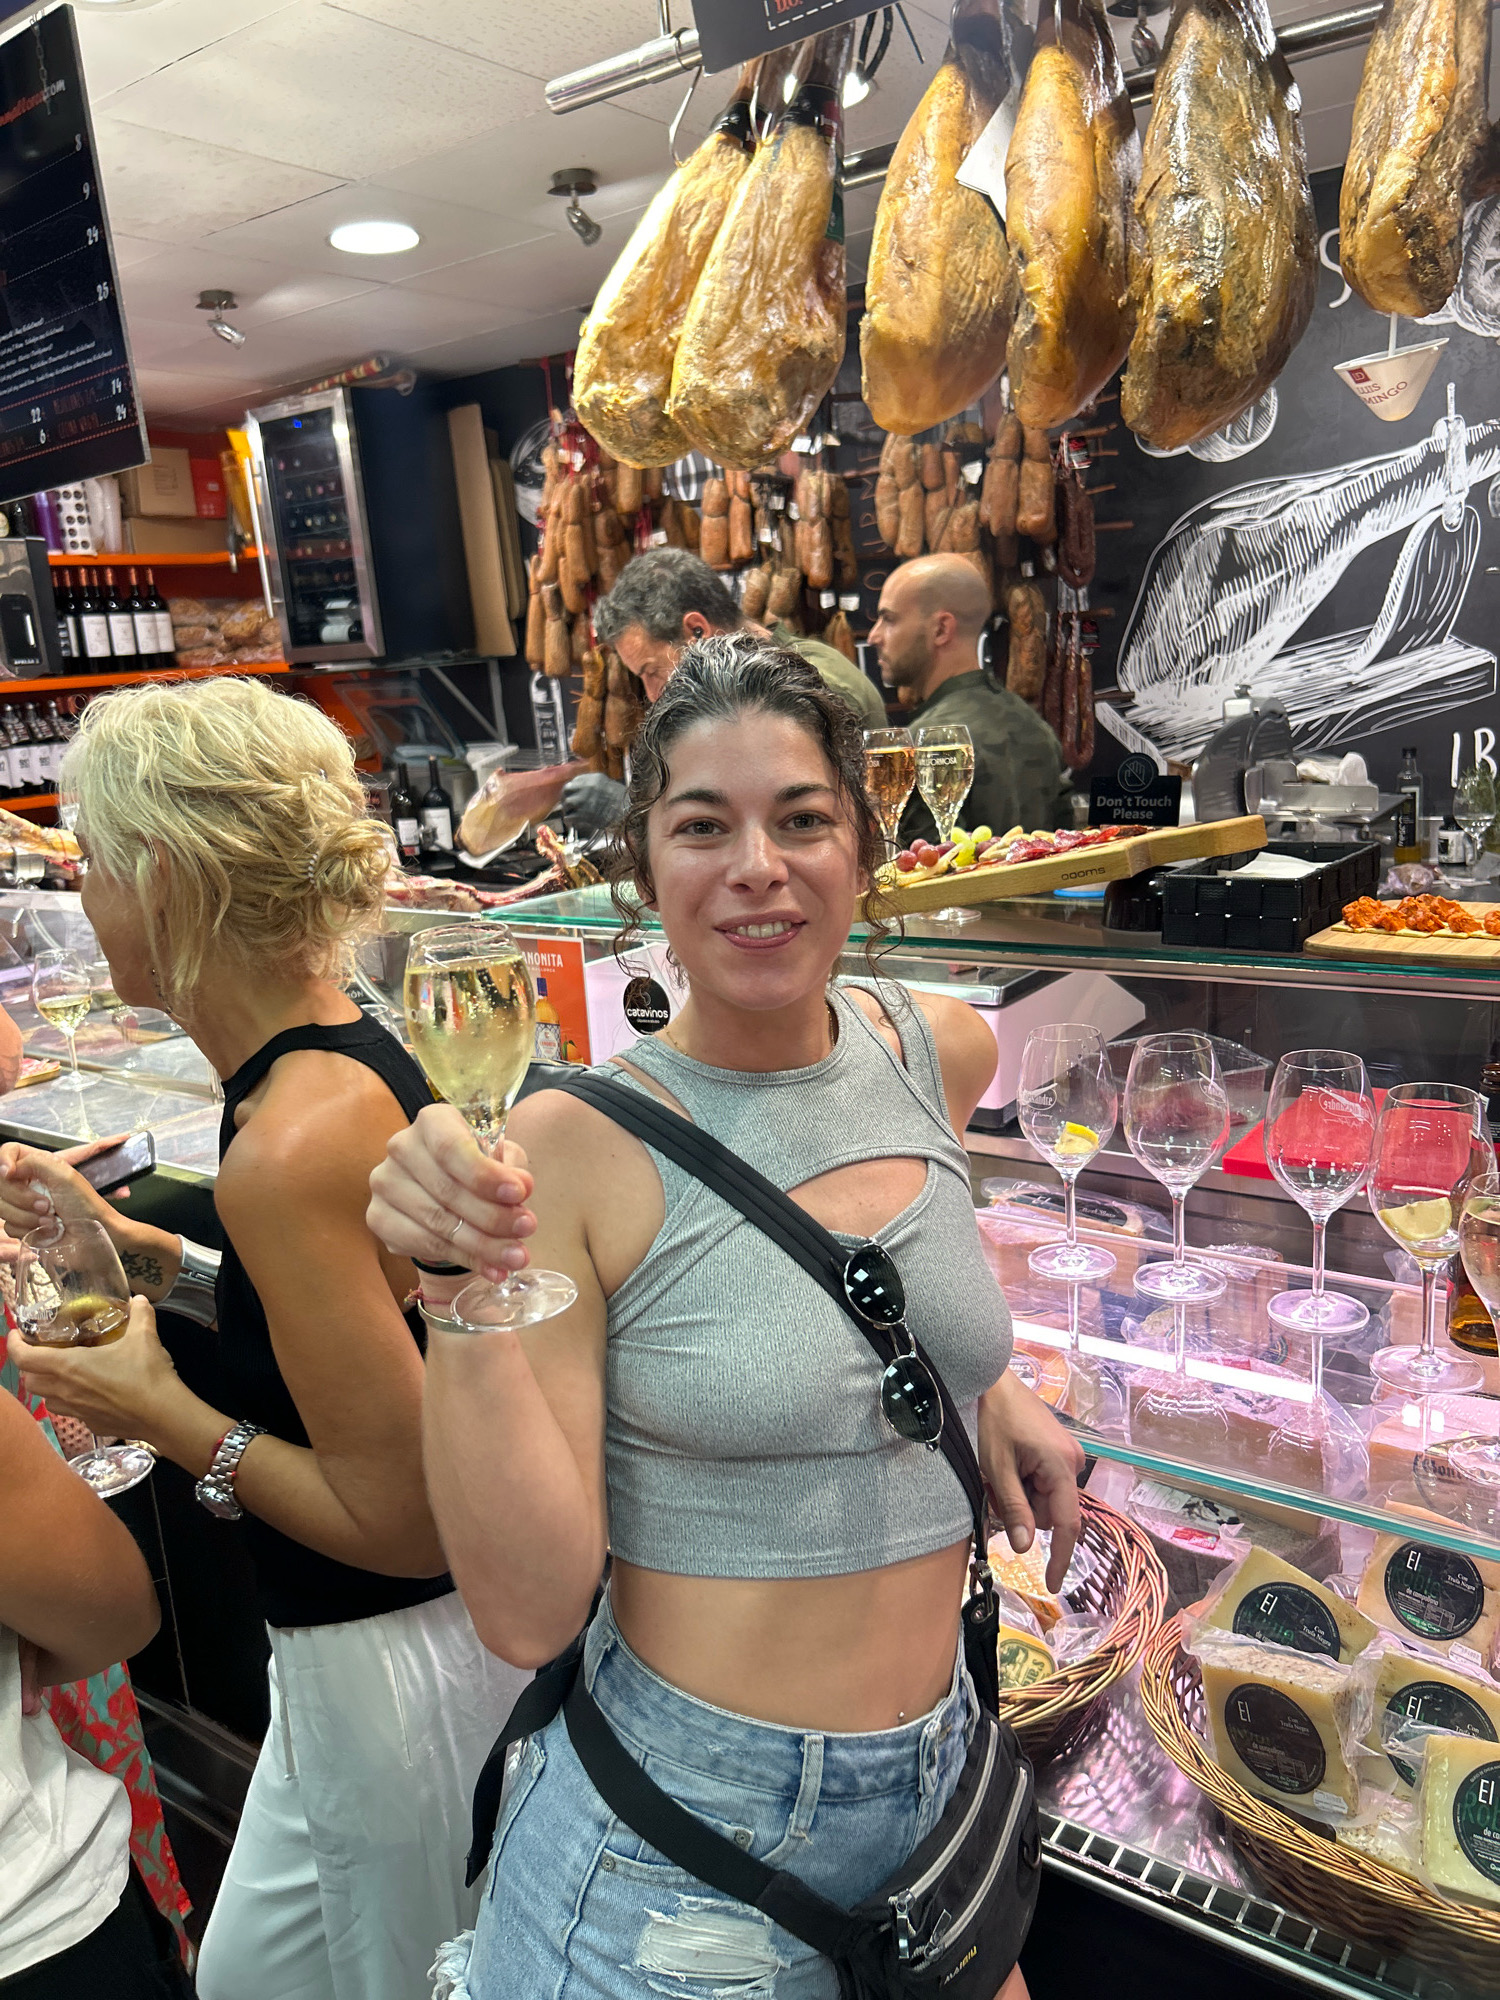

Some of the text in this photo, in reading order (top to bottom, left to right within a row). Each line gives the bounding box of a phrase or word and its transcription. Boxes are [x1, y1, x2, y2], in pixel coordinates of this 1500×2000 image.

[75, 133, 82, 151] 8
[82, 181, 91, 200] 9
[86, 225, 99, 246] 24
[96, 281, 109, 302] 25
[111, 377, 122, 395] 14
[30, 407, 41, 424] 22
[115, 403, 127, 422] 24
[39, 428, 47, 445] 6
[1134, 794, 1172, 807] Touch
[1112, 808, 1154, 820] Please
[626, 1006, 669, 1019] catavinos
[1406, 1550, 1422, 1571] El
[1447, 1574, 1476, 1591] Trufa Negra
[1457, 1573, 1469, 1582] Con
[1259, 1592, 1279, 1615] El
[1302, 1625, 1332, 1647] Trufa Negra
[1313, 1625, 1325, 1636] Con
[1237, 1700, 1251, 1723] El
[1406, 1695, 1422, 1720] El
[1478, 1779, 1495, 1806] El
